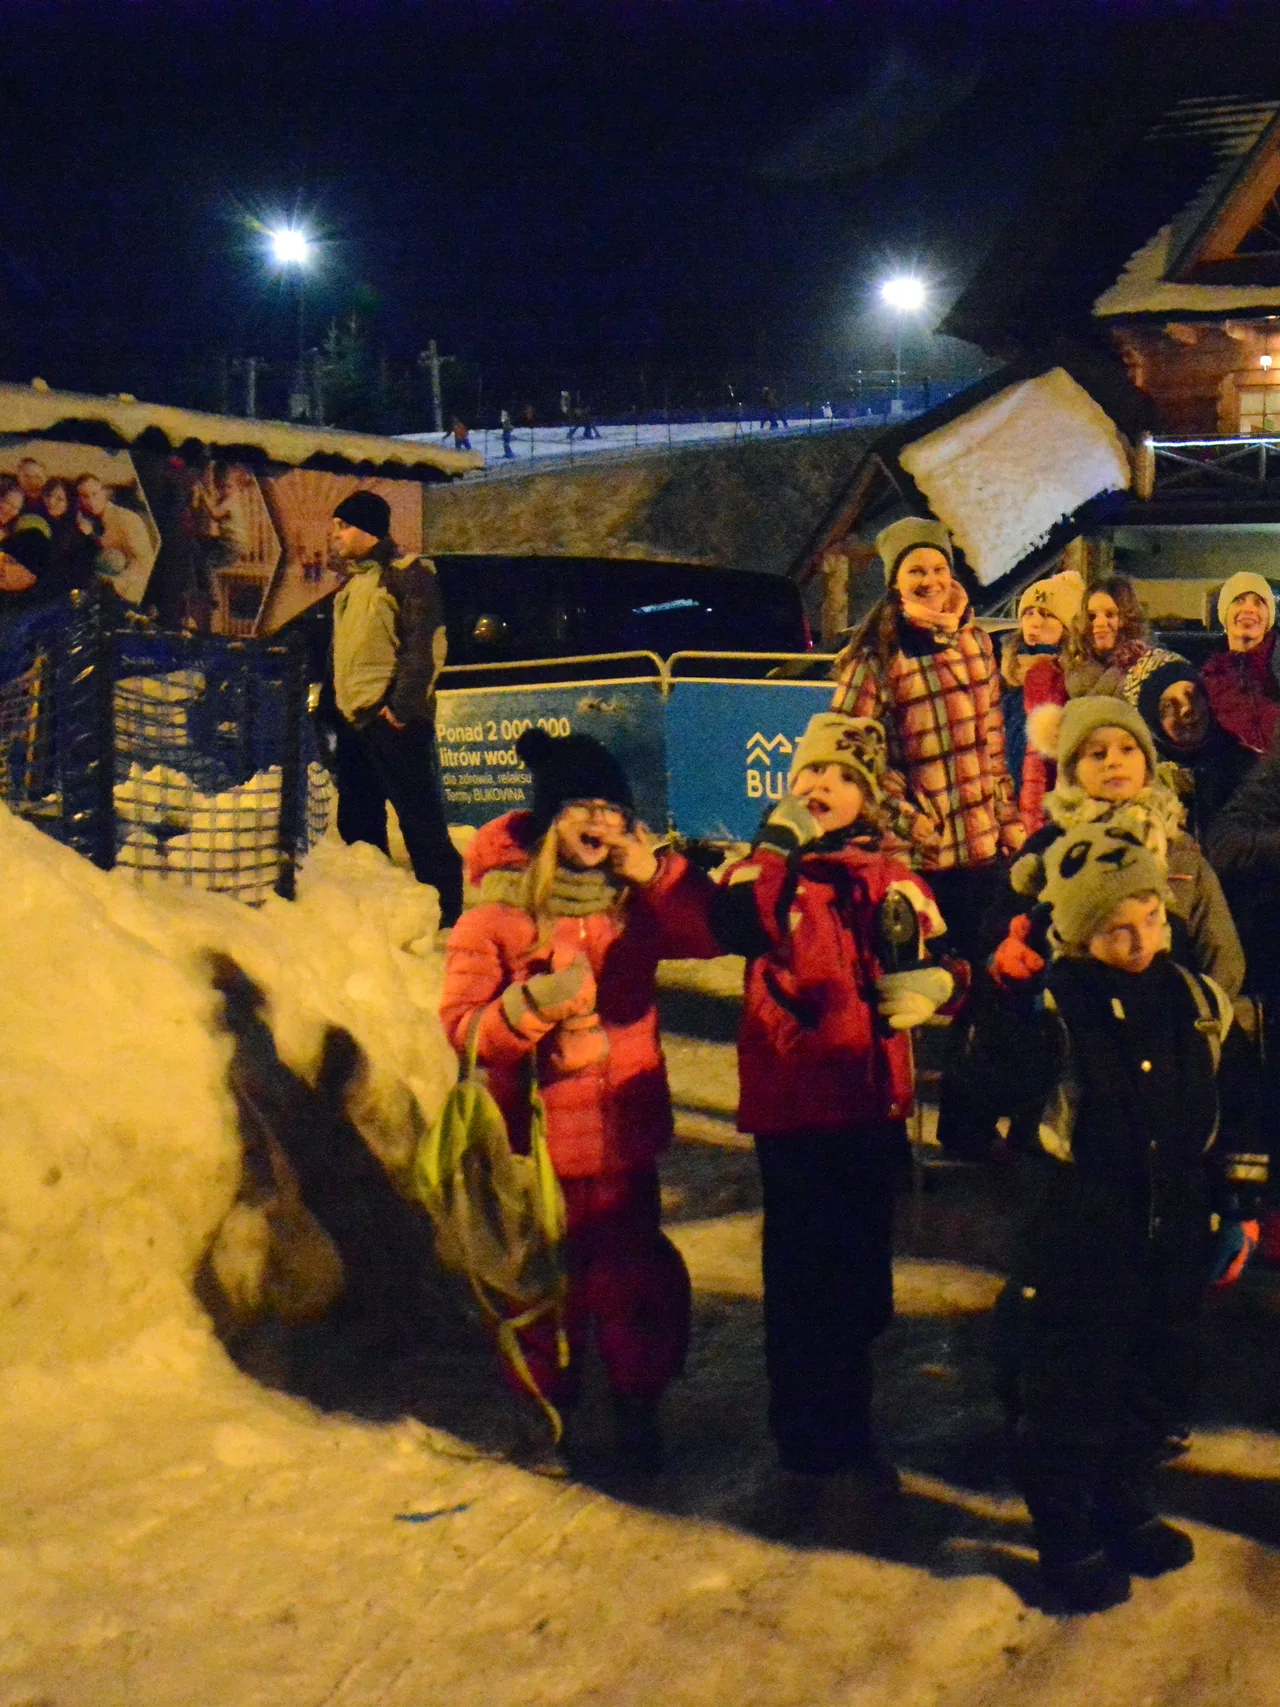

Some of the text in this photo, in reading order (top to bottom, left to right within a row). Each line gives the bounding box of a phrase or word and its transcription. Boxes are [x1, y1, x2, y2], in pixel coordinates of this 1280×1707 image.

[436, 721, 484, 741] Ponad
[487, 720, 498, 741] 2
[440, 745, 481, 767] litrów
[473, 787, 526, 801] BUKOVINA
